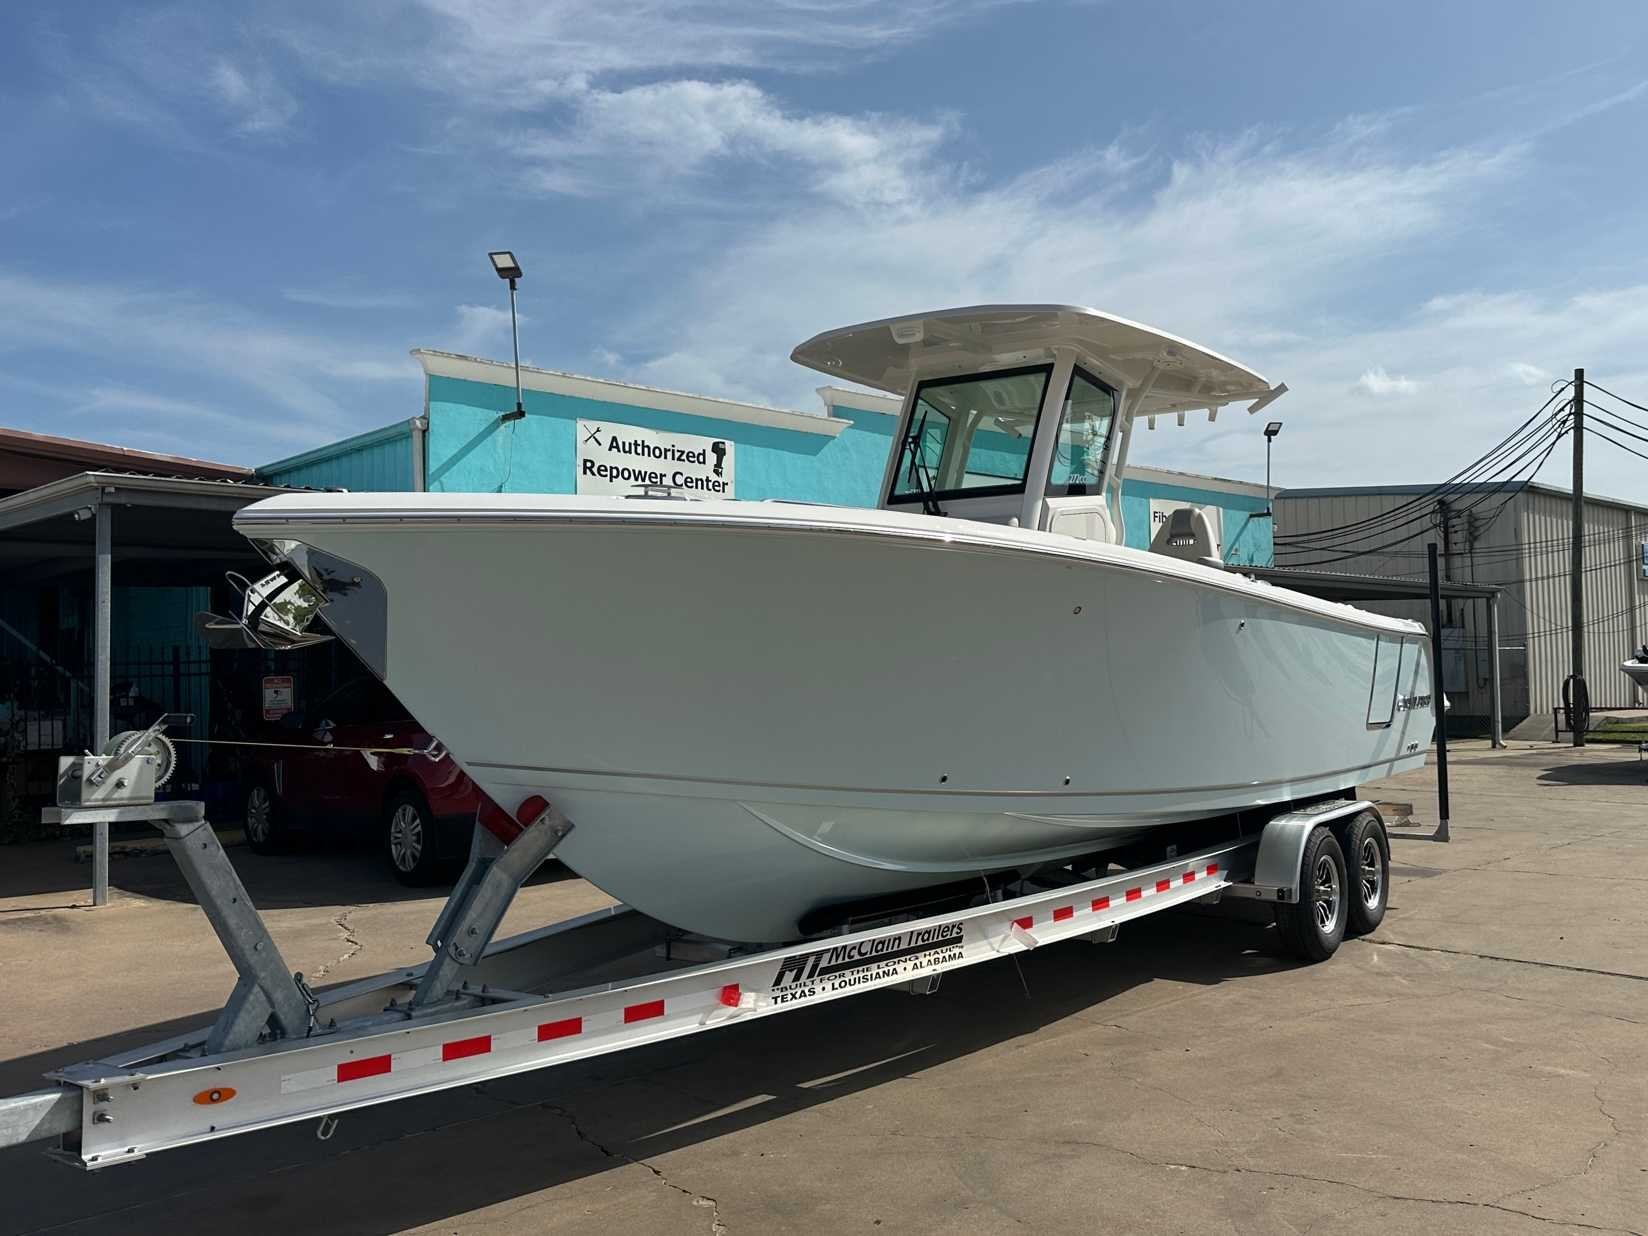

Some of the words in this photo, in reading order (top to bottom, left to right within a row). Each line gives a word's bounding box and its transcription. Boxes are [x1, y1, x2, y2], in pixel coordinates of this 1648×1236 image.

[608, 435, 707, 465] Authorized
[582, 458, 667, 483] Repower
[671, 471, 729, 494] Center
[827, 936, 902, 965] McClain
[907, 922, 964, 947] Trailers
[771, 987, 817, 1006] TEXAS
[831, 967, 899, 992] LOUISIANA
[911, 951, 965, 972] ALABAMA
[819, 972, 846, 984] FOR
[849, 965, 873, 977] THE
[876, 955, 920, 970] LONG
